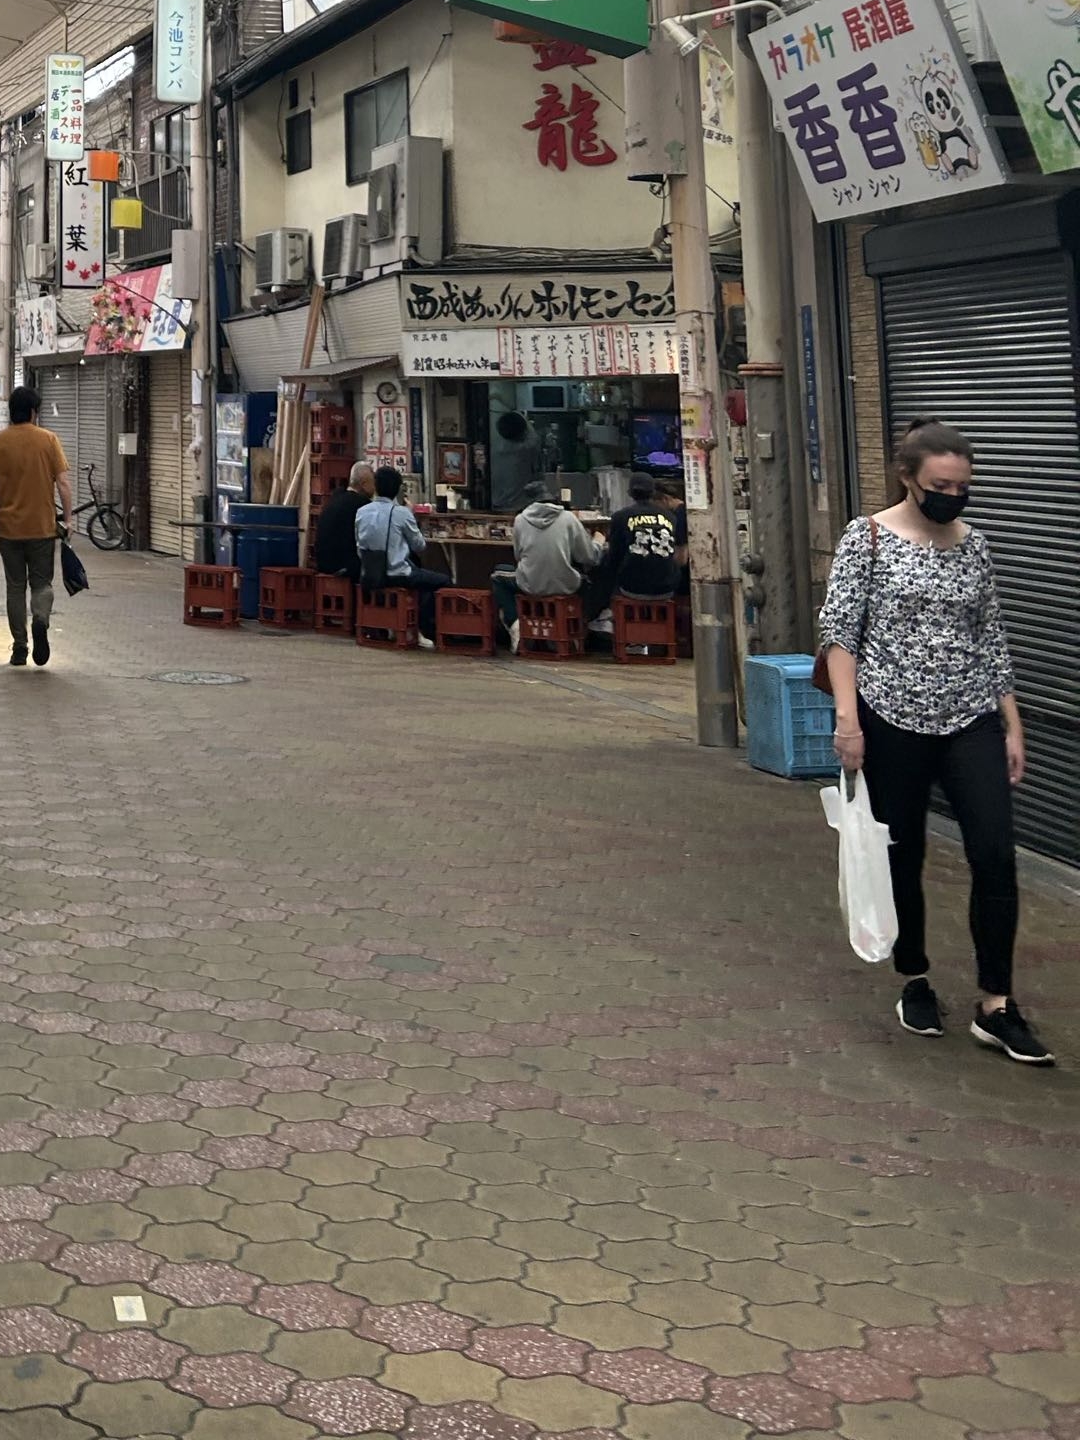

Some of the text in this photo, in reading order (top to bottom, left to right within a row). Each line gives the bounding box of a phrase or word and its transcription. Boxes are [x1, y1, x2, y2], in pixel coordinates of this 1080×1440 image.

[167, 10, 184, 90] 今池コンパ
[766, 22, 836, 81] カラオケ
[59, 84, 71, 144] デンスケ
[69, 88, 83, 145] 一品料理
[783, 61, 907, 185] 香香
[64, 161, 89, 252] 紅葉
